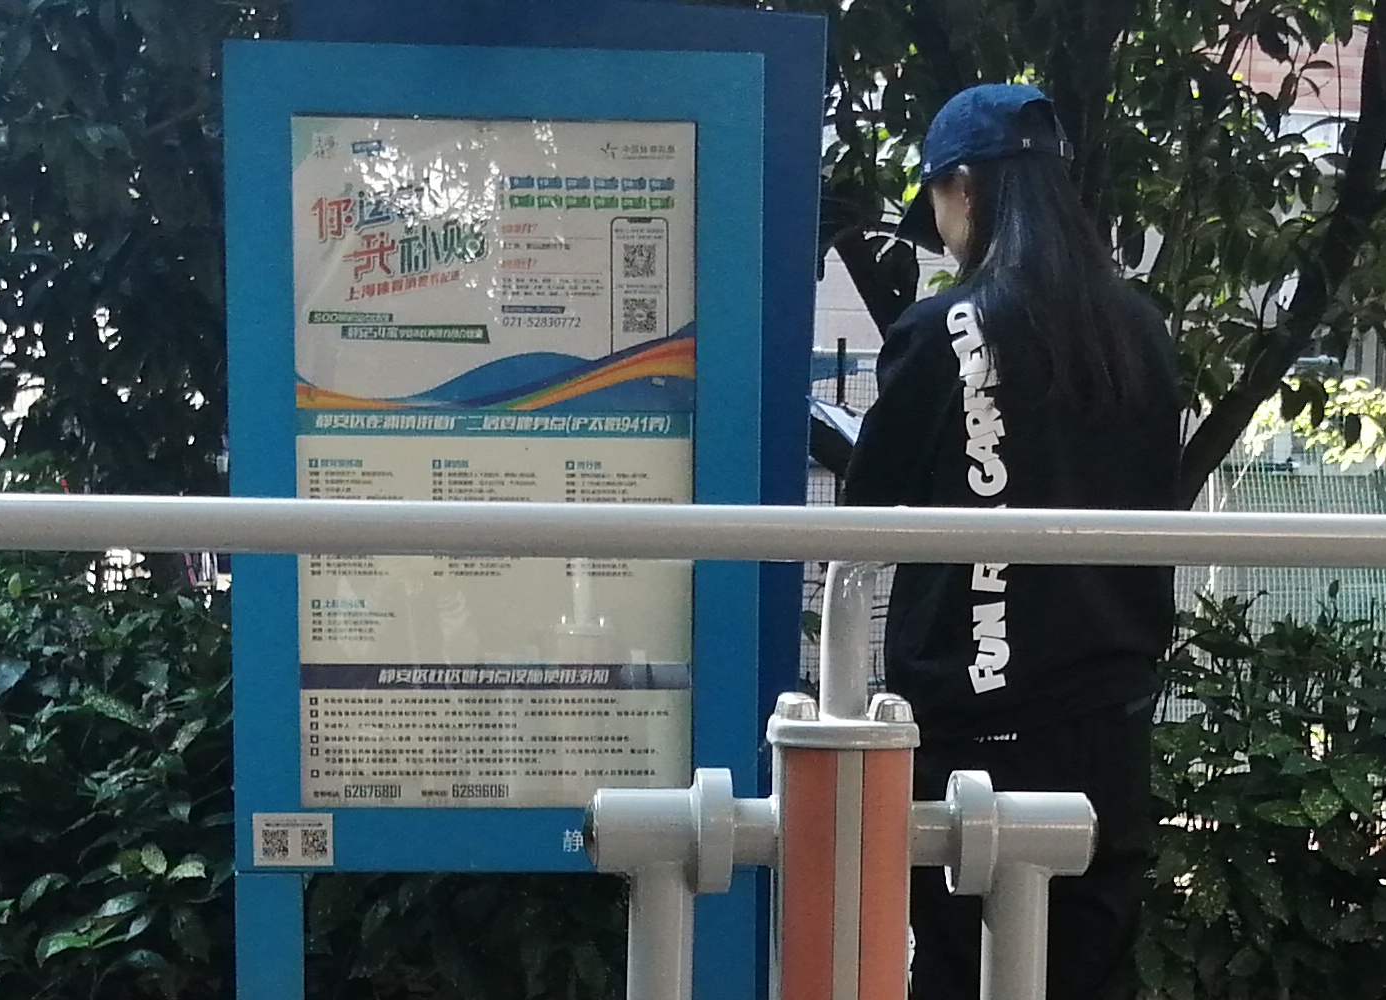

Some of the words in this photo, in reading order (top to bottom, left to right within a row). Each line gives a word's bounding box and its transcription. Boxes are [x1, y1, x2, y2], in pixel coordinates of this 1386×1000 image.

[502, 316, 582, 328] 021-52830772
[946, 302, 1008, 497] GARFIELD
[968, 601, 1011, 694] FUN
[378, 668, 610, 685] 静安区社区健身点设施使用须知
[344, 784, 402, 799] 62676801
[562, 829, 585, 853] 静
